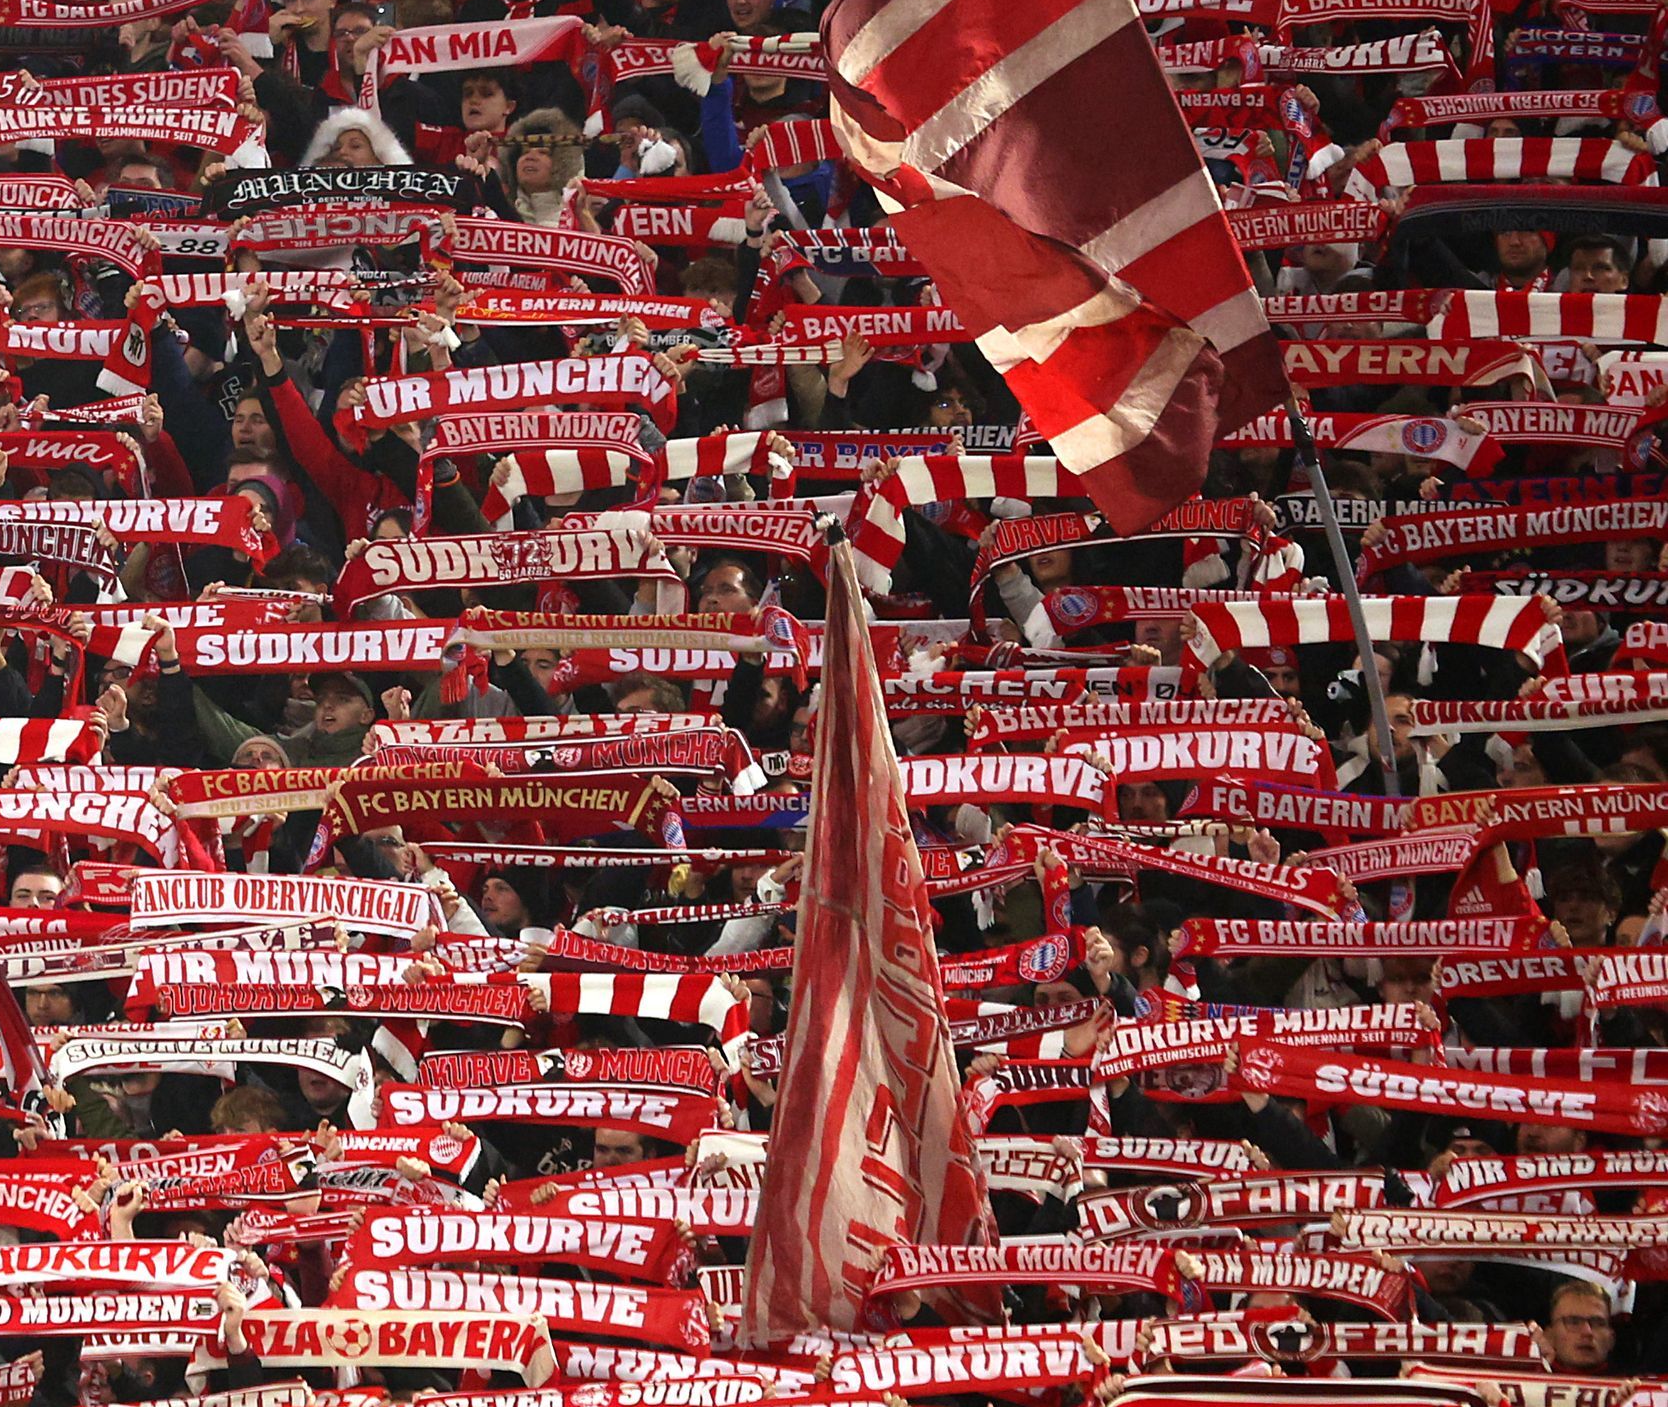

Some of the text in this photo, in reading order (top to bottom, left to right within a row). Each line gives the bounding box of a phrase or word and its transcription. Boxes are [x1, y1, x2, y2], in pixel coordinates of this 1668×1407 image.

[455, 29, 518, 61] MIA
[36, 219, 149, 262] MÜNCHEN
[1284, 345, 1469, 376] AYERN
[358, 782, 632, 820] FC BAYERN MÜNCHEN
[134, 873, 418, 925] FANCLUB OBERVINSCHGAU
[1214, 919, 1515, 948] FC BAYERN MÜNCHEN
[392, 1091, 681, 1127] SÜDKURVE
[1315, 1063, 1597, 1121] SÜDKURVE
[1448, 1154, 1597, 1191] WIR SIND
[371, 1214, 656, 1265] SÜDKURVE
[1251, 1256, 1385, 1299] MÜNCHEN
[20, 1295, 185, 1325] MÜNCHEN
[355, 1272, 649, 1332] SÜDKURVE
